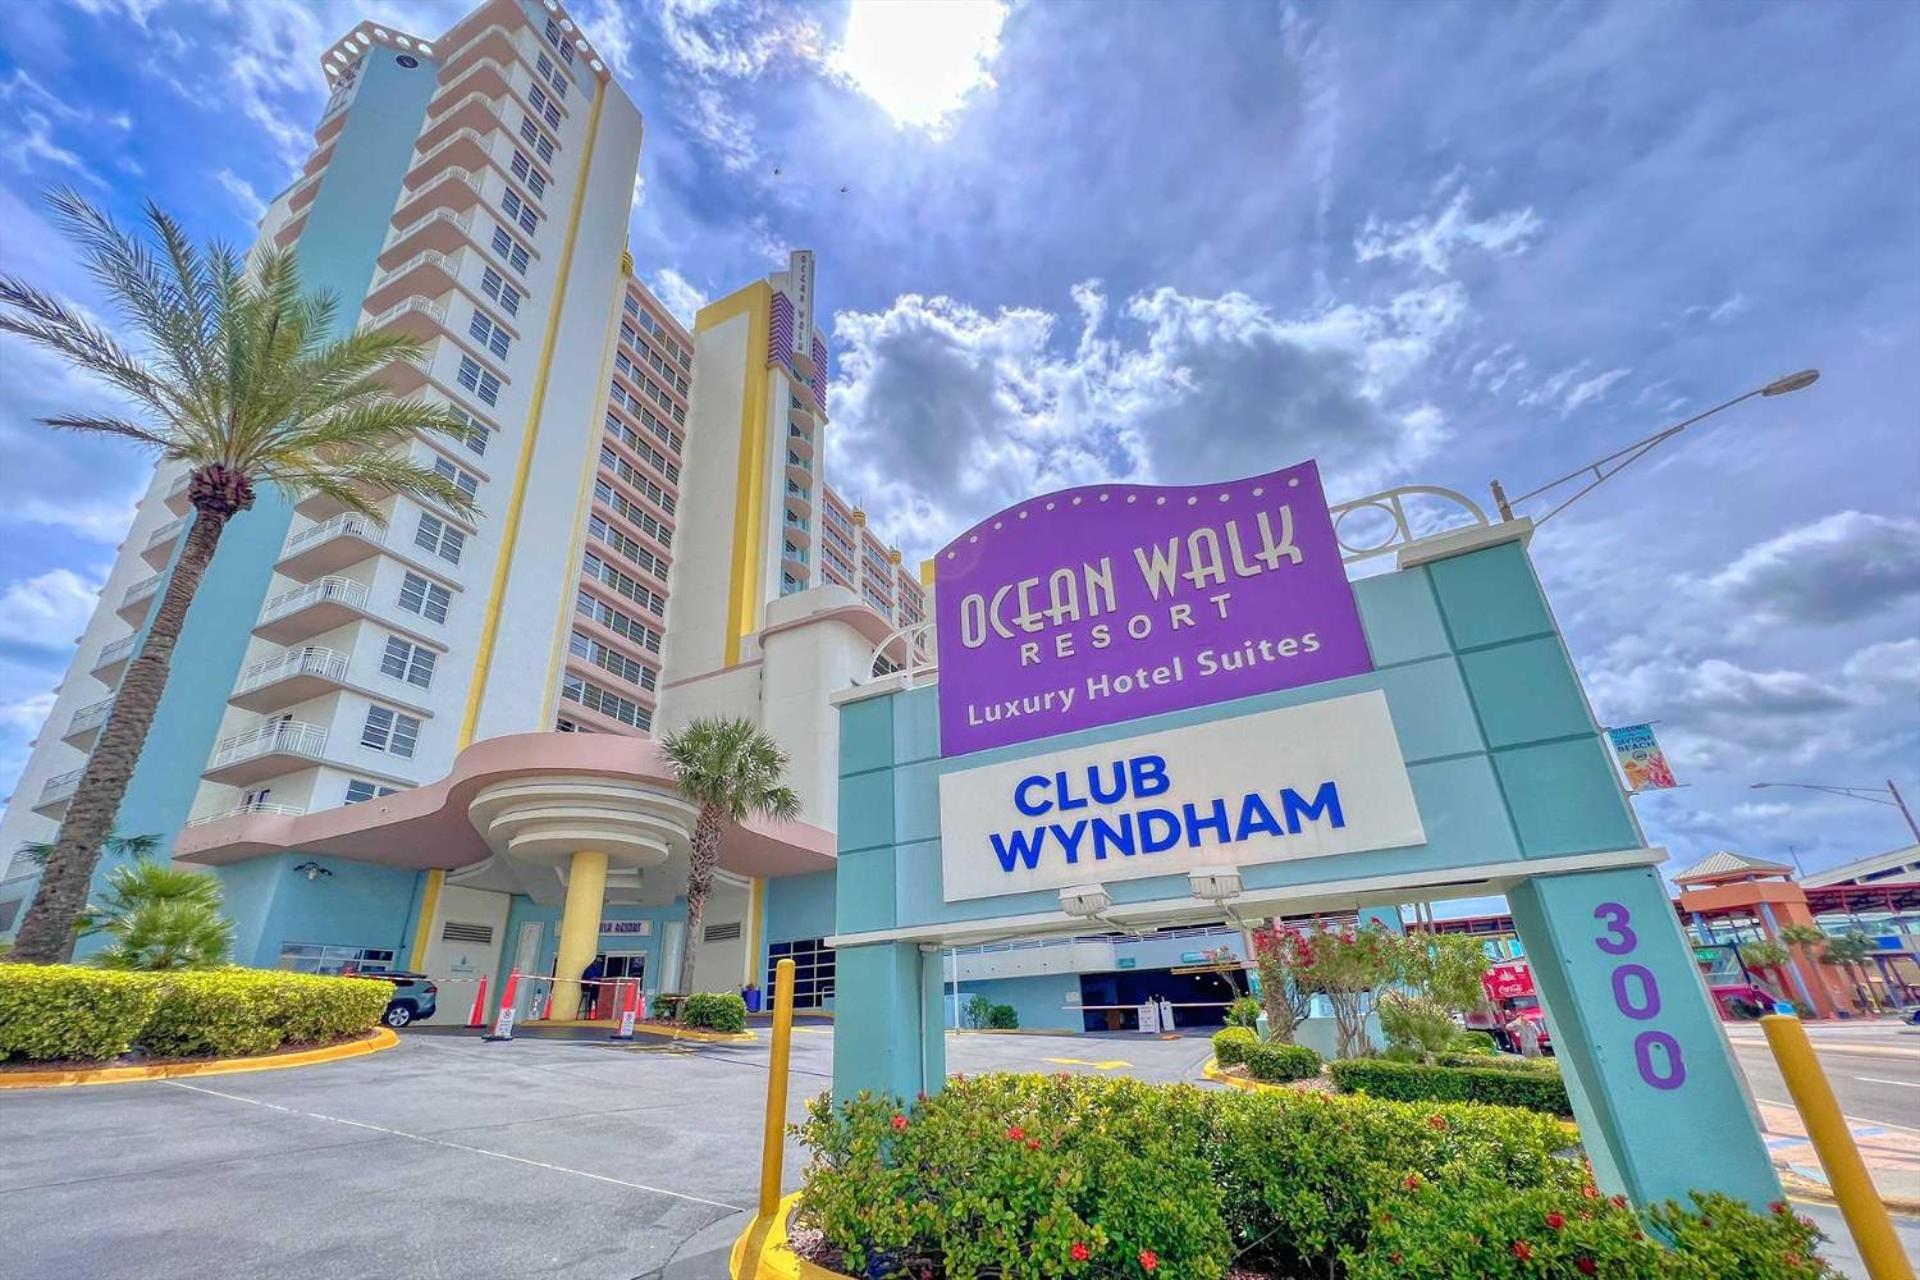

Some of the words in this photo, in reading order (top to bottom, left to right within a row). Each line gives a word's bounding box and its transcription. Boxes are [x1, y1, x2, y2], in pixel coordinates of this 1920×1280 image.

[960, 556, 1117, 649] OCEAN
[1133, 504, 1304, 601] WALK
[1020, 593, 1232, 666] RESORT
[968, 685, 1076, 727] Luxury
[1087, 655, 1184, 701] Hotel
[1198, 629, 1322, 678] Suites
[989, 780, 1346, 874] WYNDHAM
[1014, 754, 1171, 817] CLUB
[1594, 902, 1686, 1090] 300
